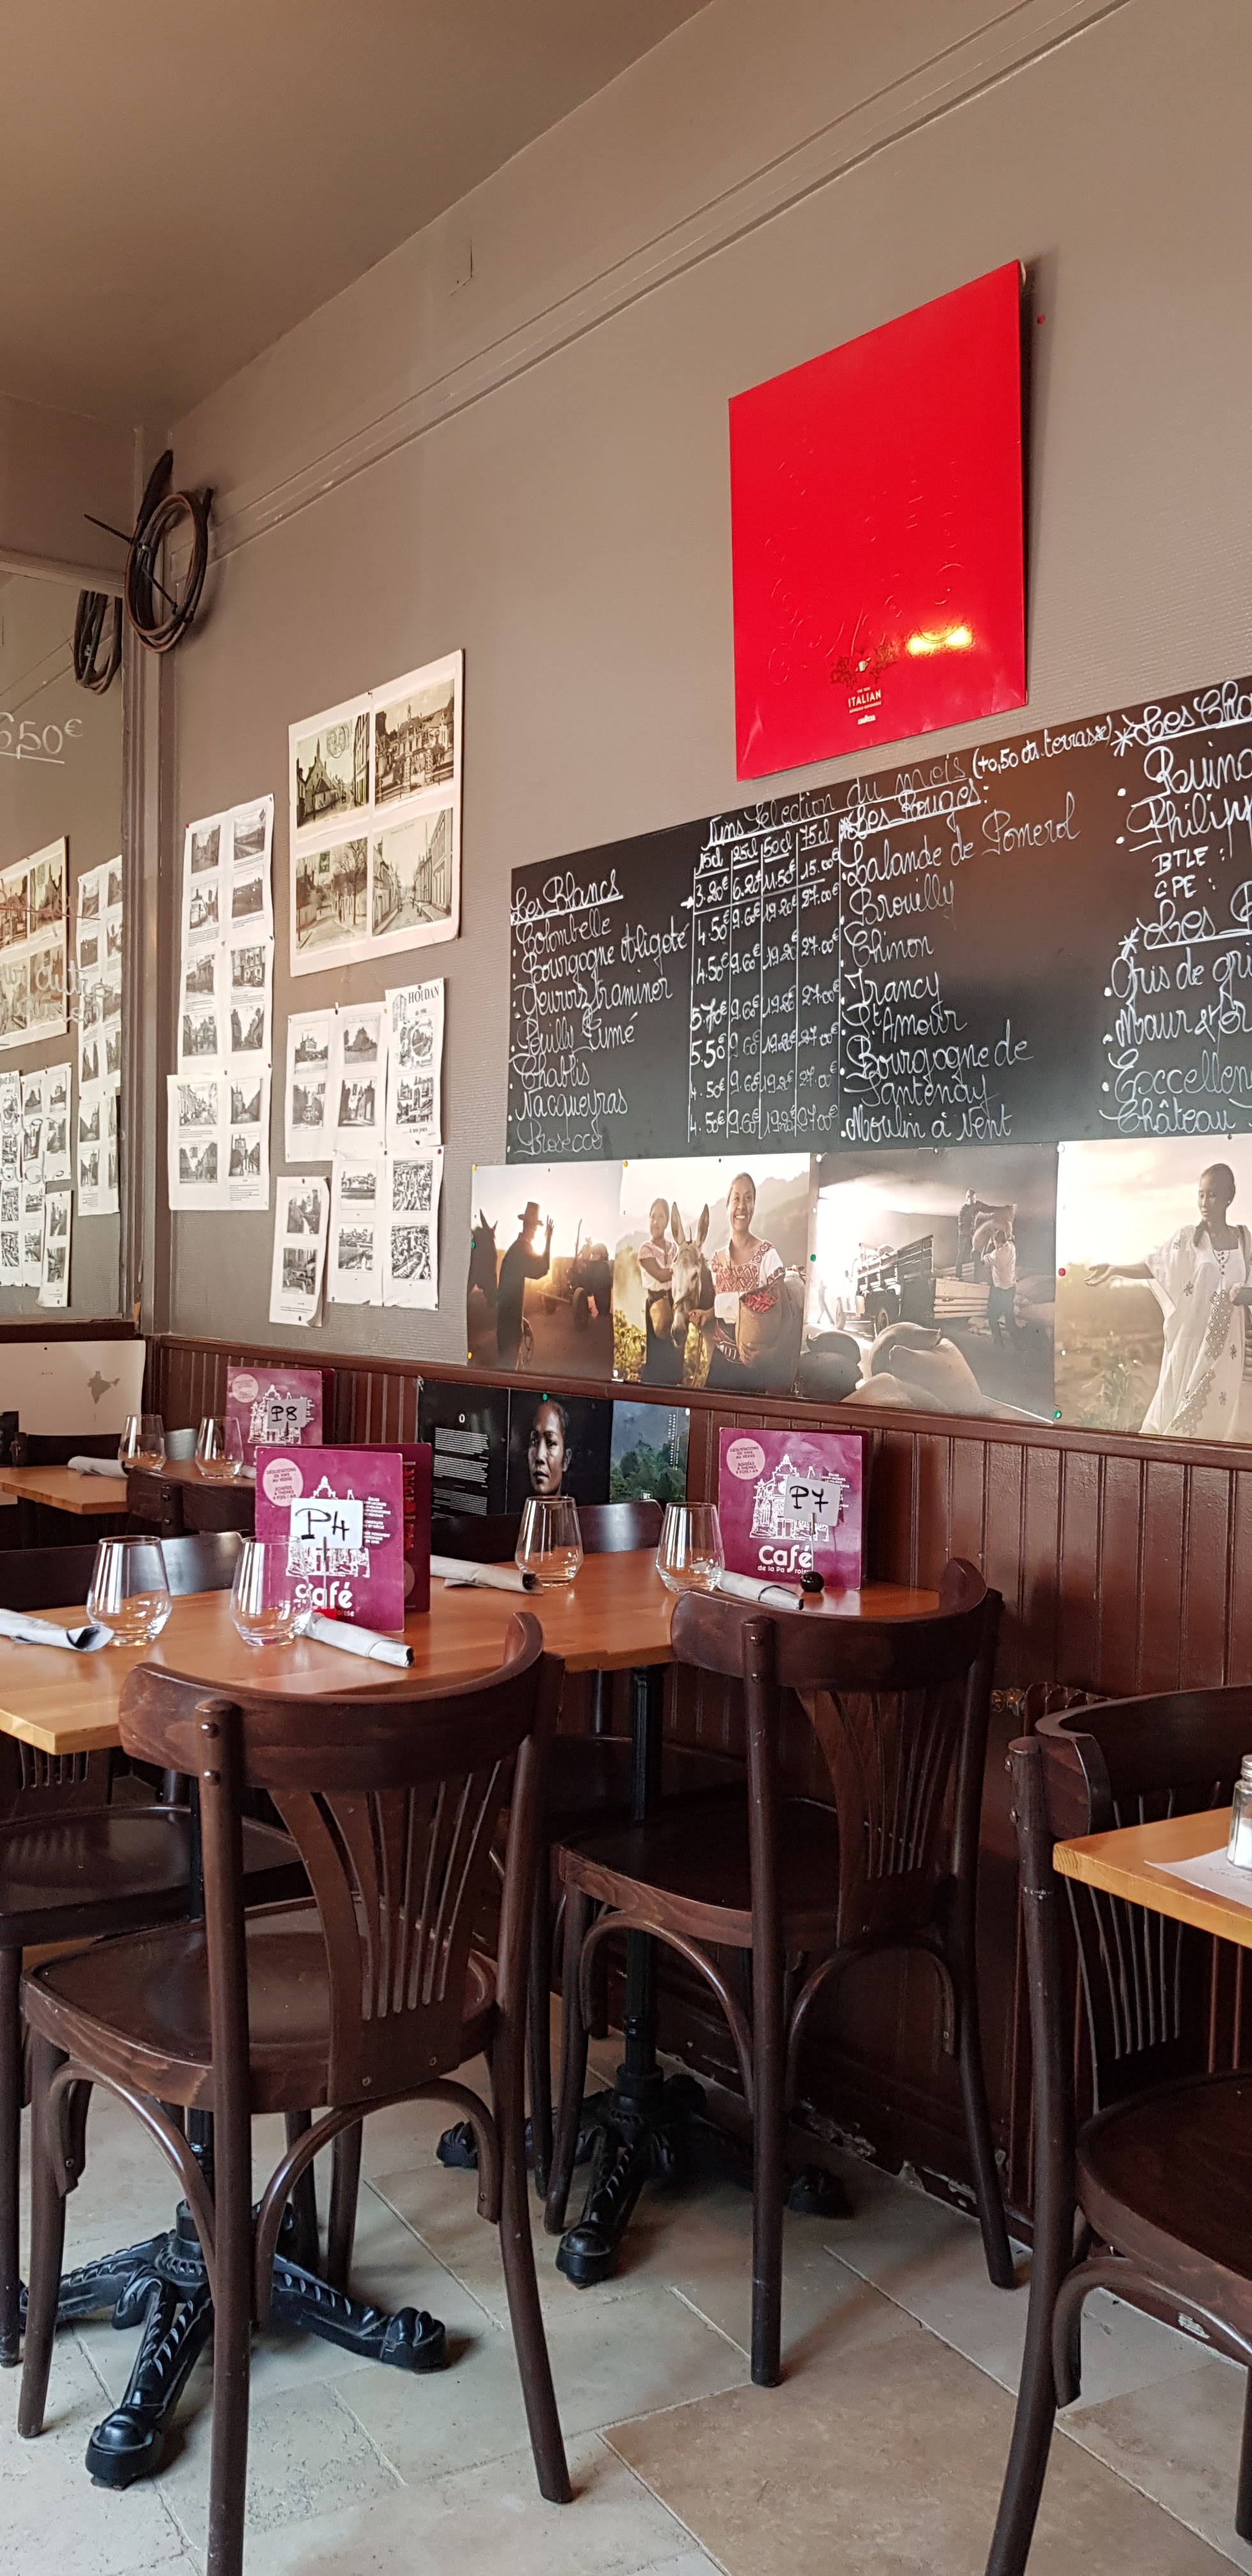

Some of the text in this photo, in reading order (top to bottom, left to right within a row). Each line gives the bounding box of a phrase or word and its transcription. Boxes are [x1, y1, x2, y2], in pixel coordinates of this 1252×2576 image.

[848, 689, 882, 708] ITALIAN
[847, 777, 883, 808] du
[894, 754, 966, 801] mois
[950, 825, 975, 866] de
[1177, 947, 1205, 990] de
[408, 986, 439, 1004] HOUDAN
[995, 1019, 1035, 1067] de
[271, 1406, 298, 1422] P8
[789, 1485, 829, 1514] P7
[294, 1508, 350, 1542] P4
[758, 1544, 813, 1573] Café
[295, 1581, 353, 1609] Café
